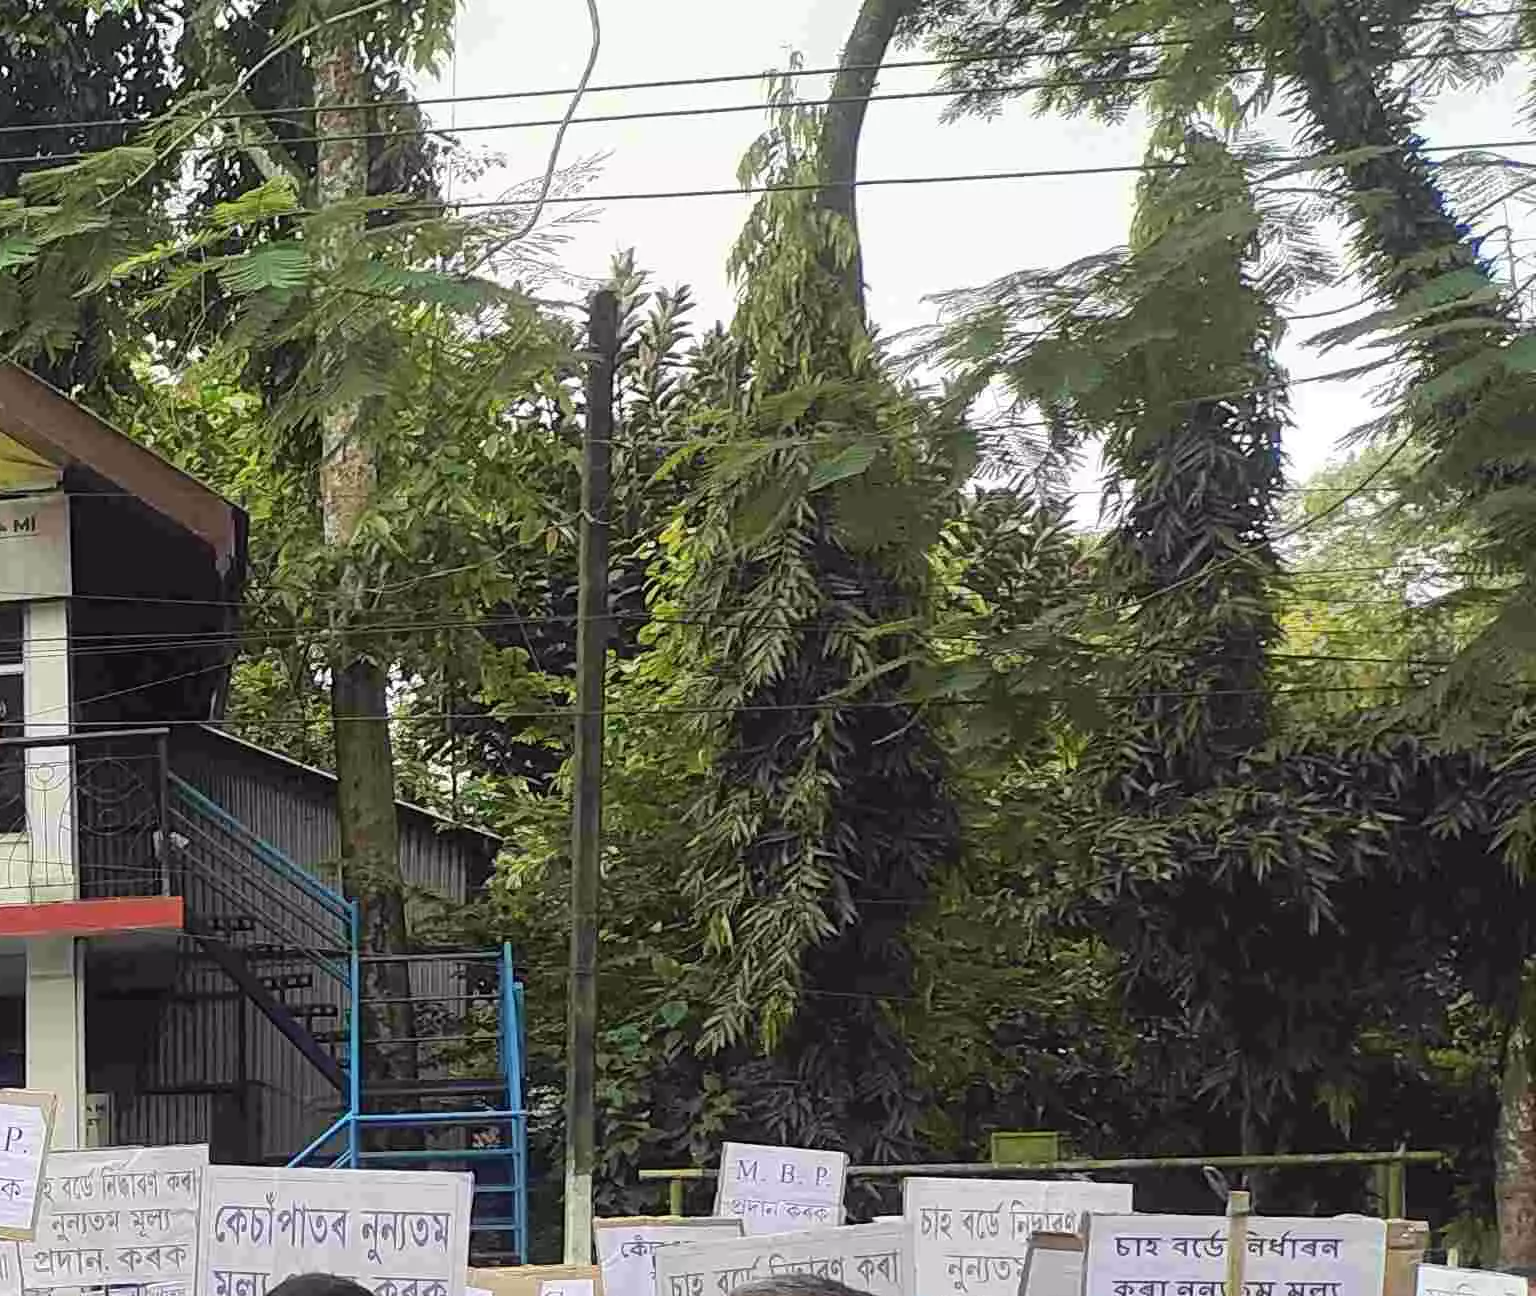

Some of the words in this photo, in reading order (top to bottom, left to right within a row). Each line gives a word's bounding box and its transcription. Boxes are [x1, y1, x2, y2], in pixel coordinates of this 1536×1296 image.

[920, 1205, 953, 1240] চাহ
[116, 1244, 190, 1273] কৰক
[1114, 1237, 1162, 1257] চাহ
